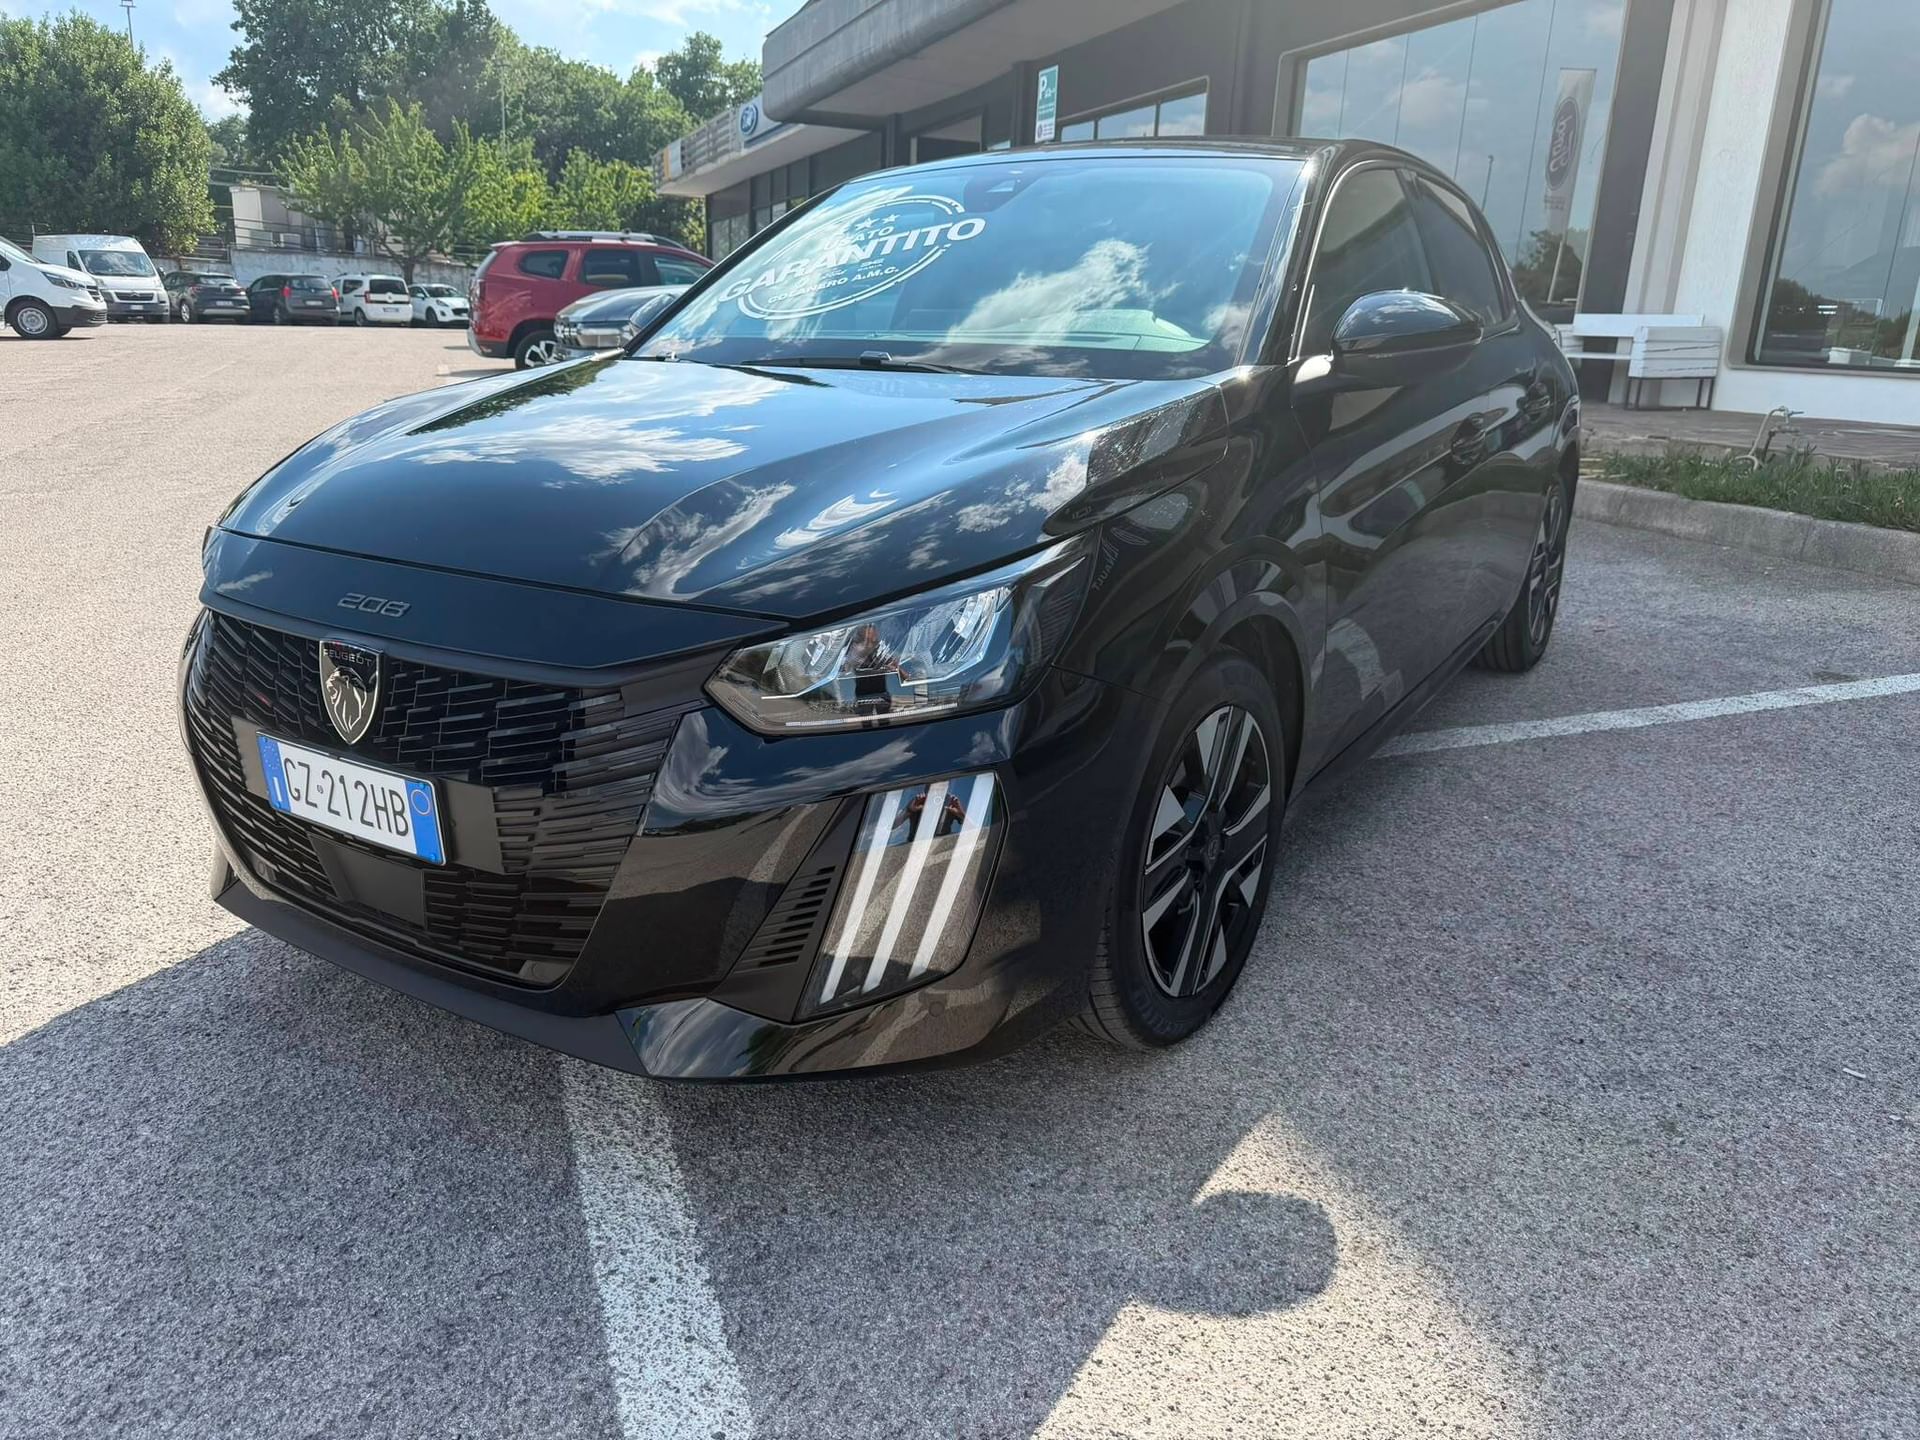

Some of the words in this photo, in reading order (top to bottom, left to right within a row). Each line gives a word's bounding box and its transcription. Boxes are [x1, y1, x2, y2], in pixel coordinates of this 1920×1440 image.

[823, 225, 896, 252] USATO
[717, 217, 986, 303] GARANTITO
[850, 265, 900, 283] A.M.C.
[336, 592, 411, 617] 208
[322, 647, 373, 668] PEUGEOT
